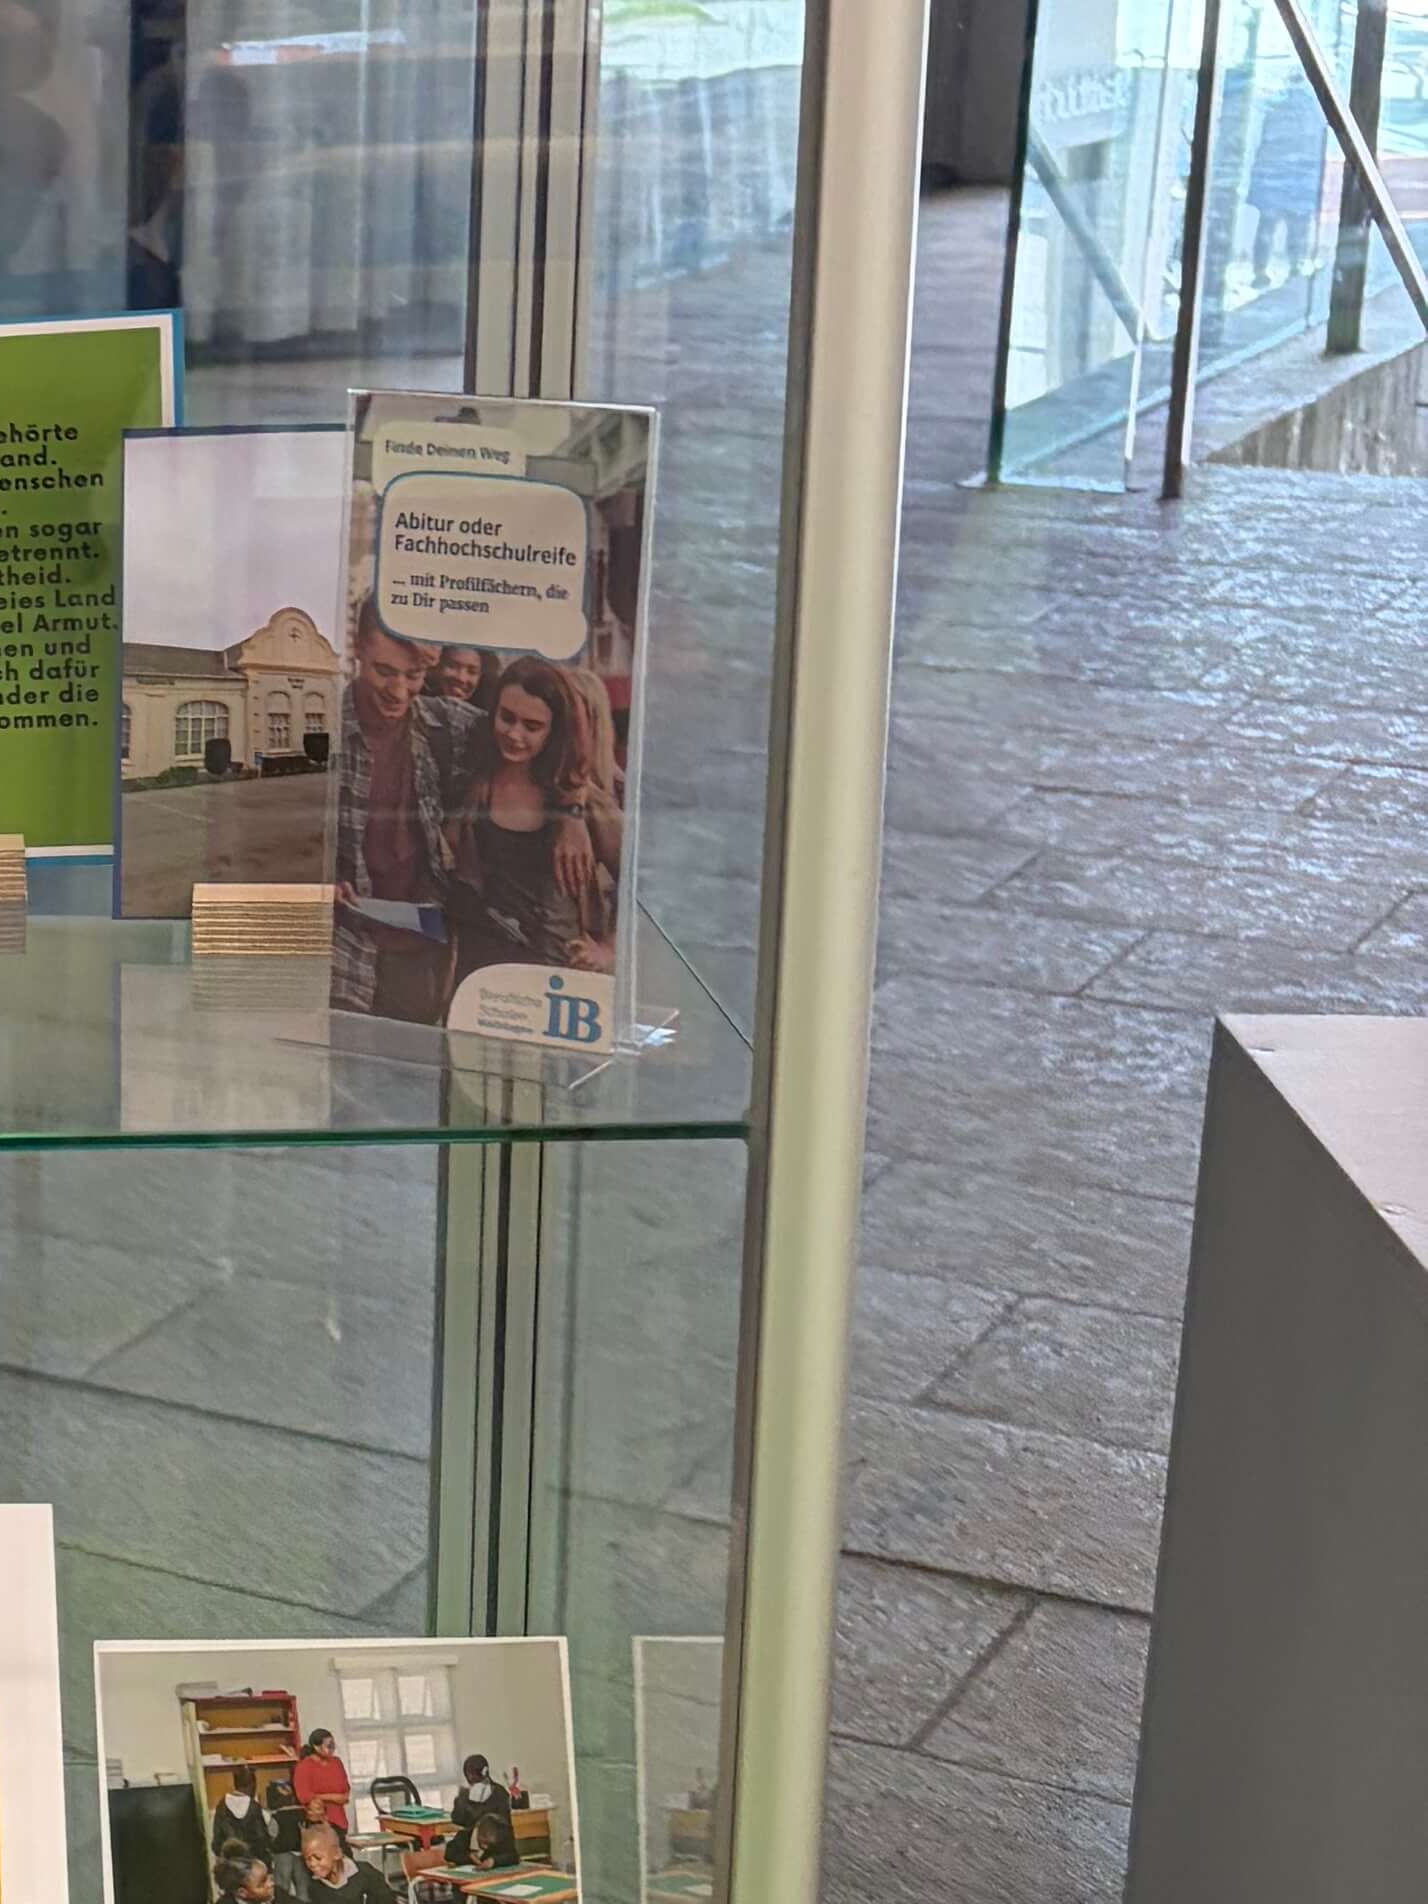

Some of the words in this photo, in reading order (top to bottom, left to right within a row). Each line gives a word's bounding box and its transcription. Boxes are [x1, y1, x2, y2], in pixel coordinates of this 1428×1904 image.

[395, 511, 455, 533] Abitur
[458, 516, 504, 537] oder
[394, 534, 577, 567] Fachhochschulreife
[410, 573, 436, 588] mit
[390, 593, 409, 606] zu
[412, 592, 436, 609] Dir
[439, 597, 490, 614] passen
